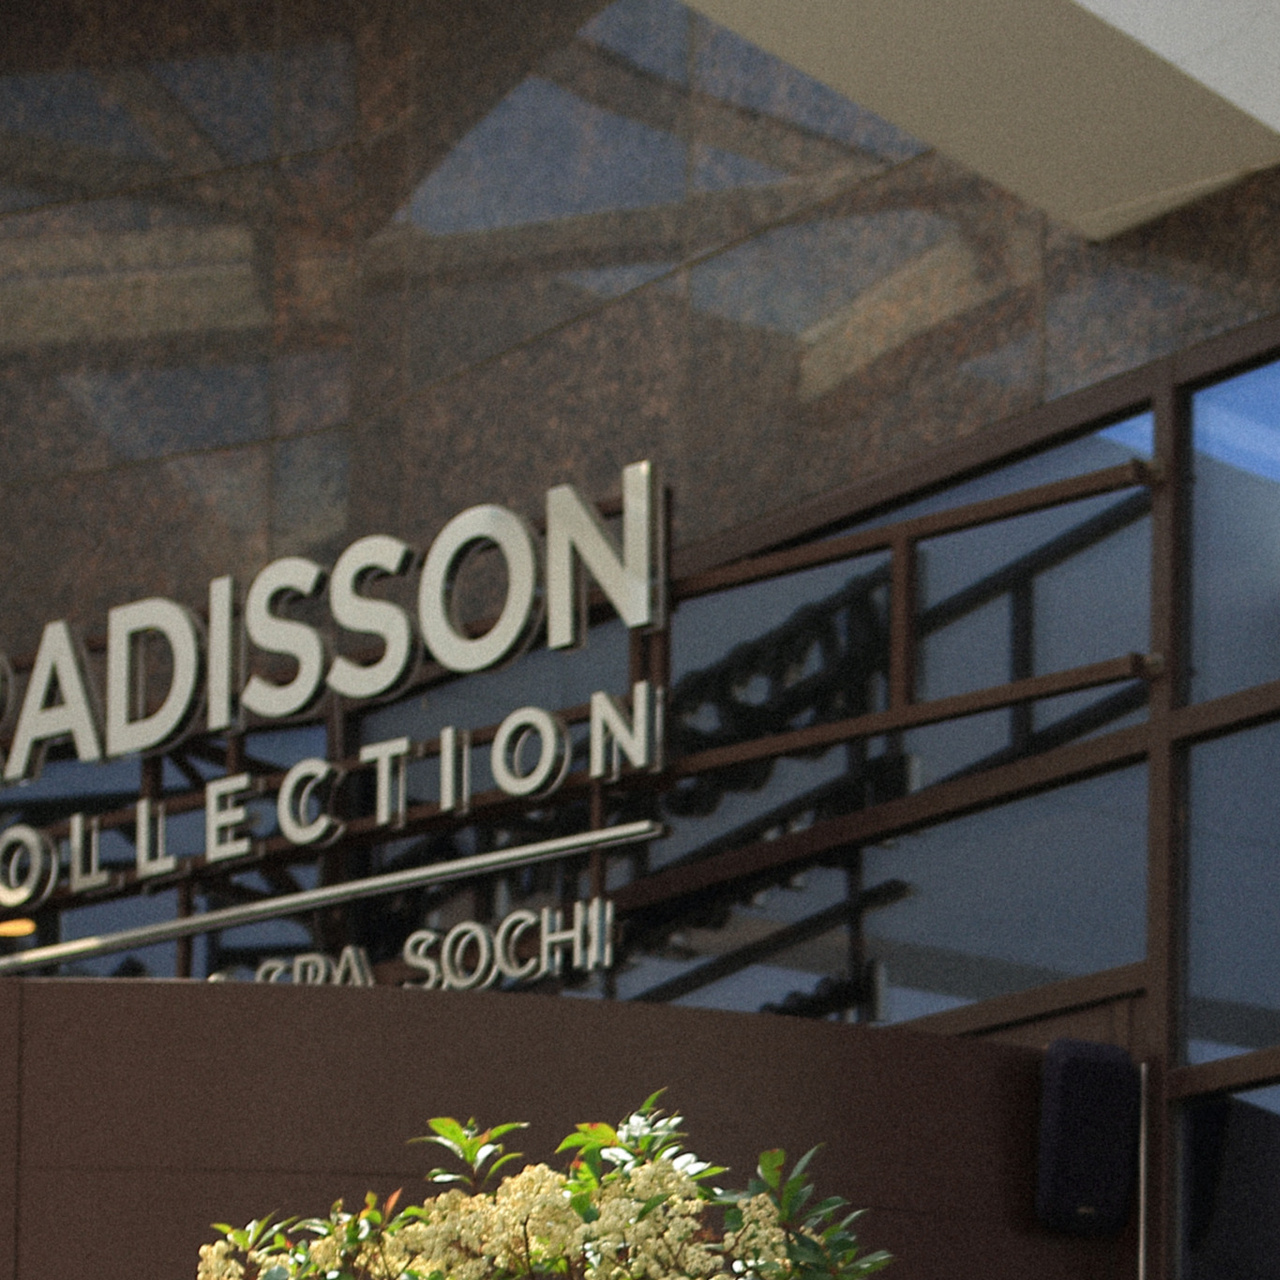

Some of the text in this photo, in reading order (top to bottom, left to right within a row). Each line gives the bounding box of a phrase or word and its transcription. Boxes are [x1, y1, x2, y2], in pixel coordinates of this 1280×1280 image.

[3, 460, 660, 782] ADISSON
[0, 680, 660, 908] OLLECTION
[403, 897, 612, 990] SOCHI
